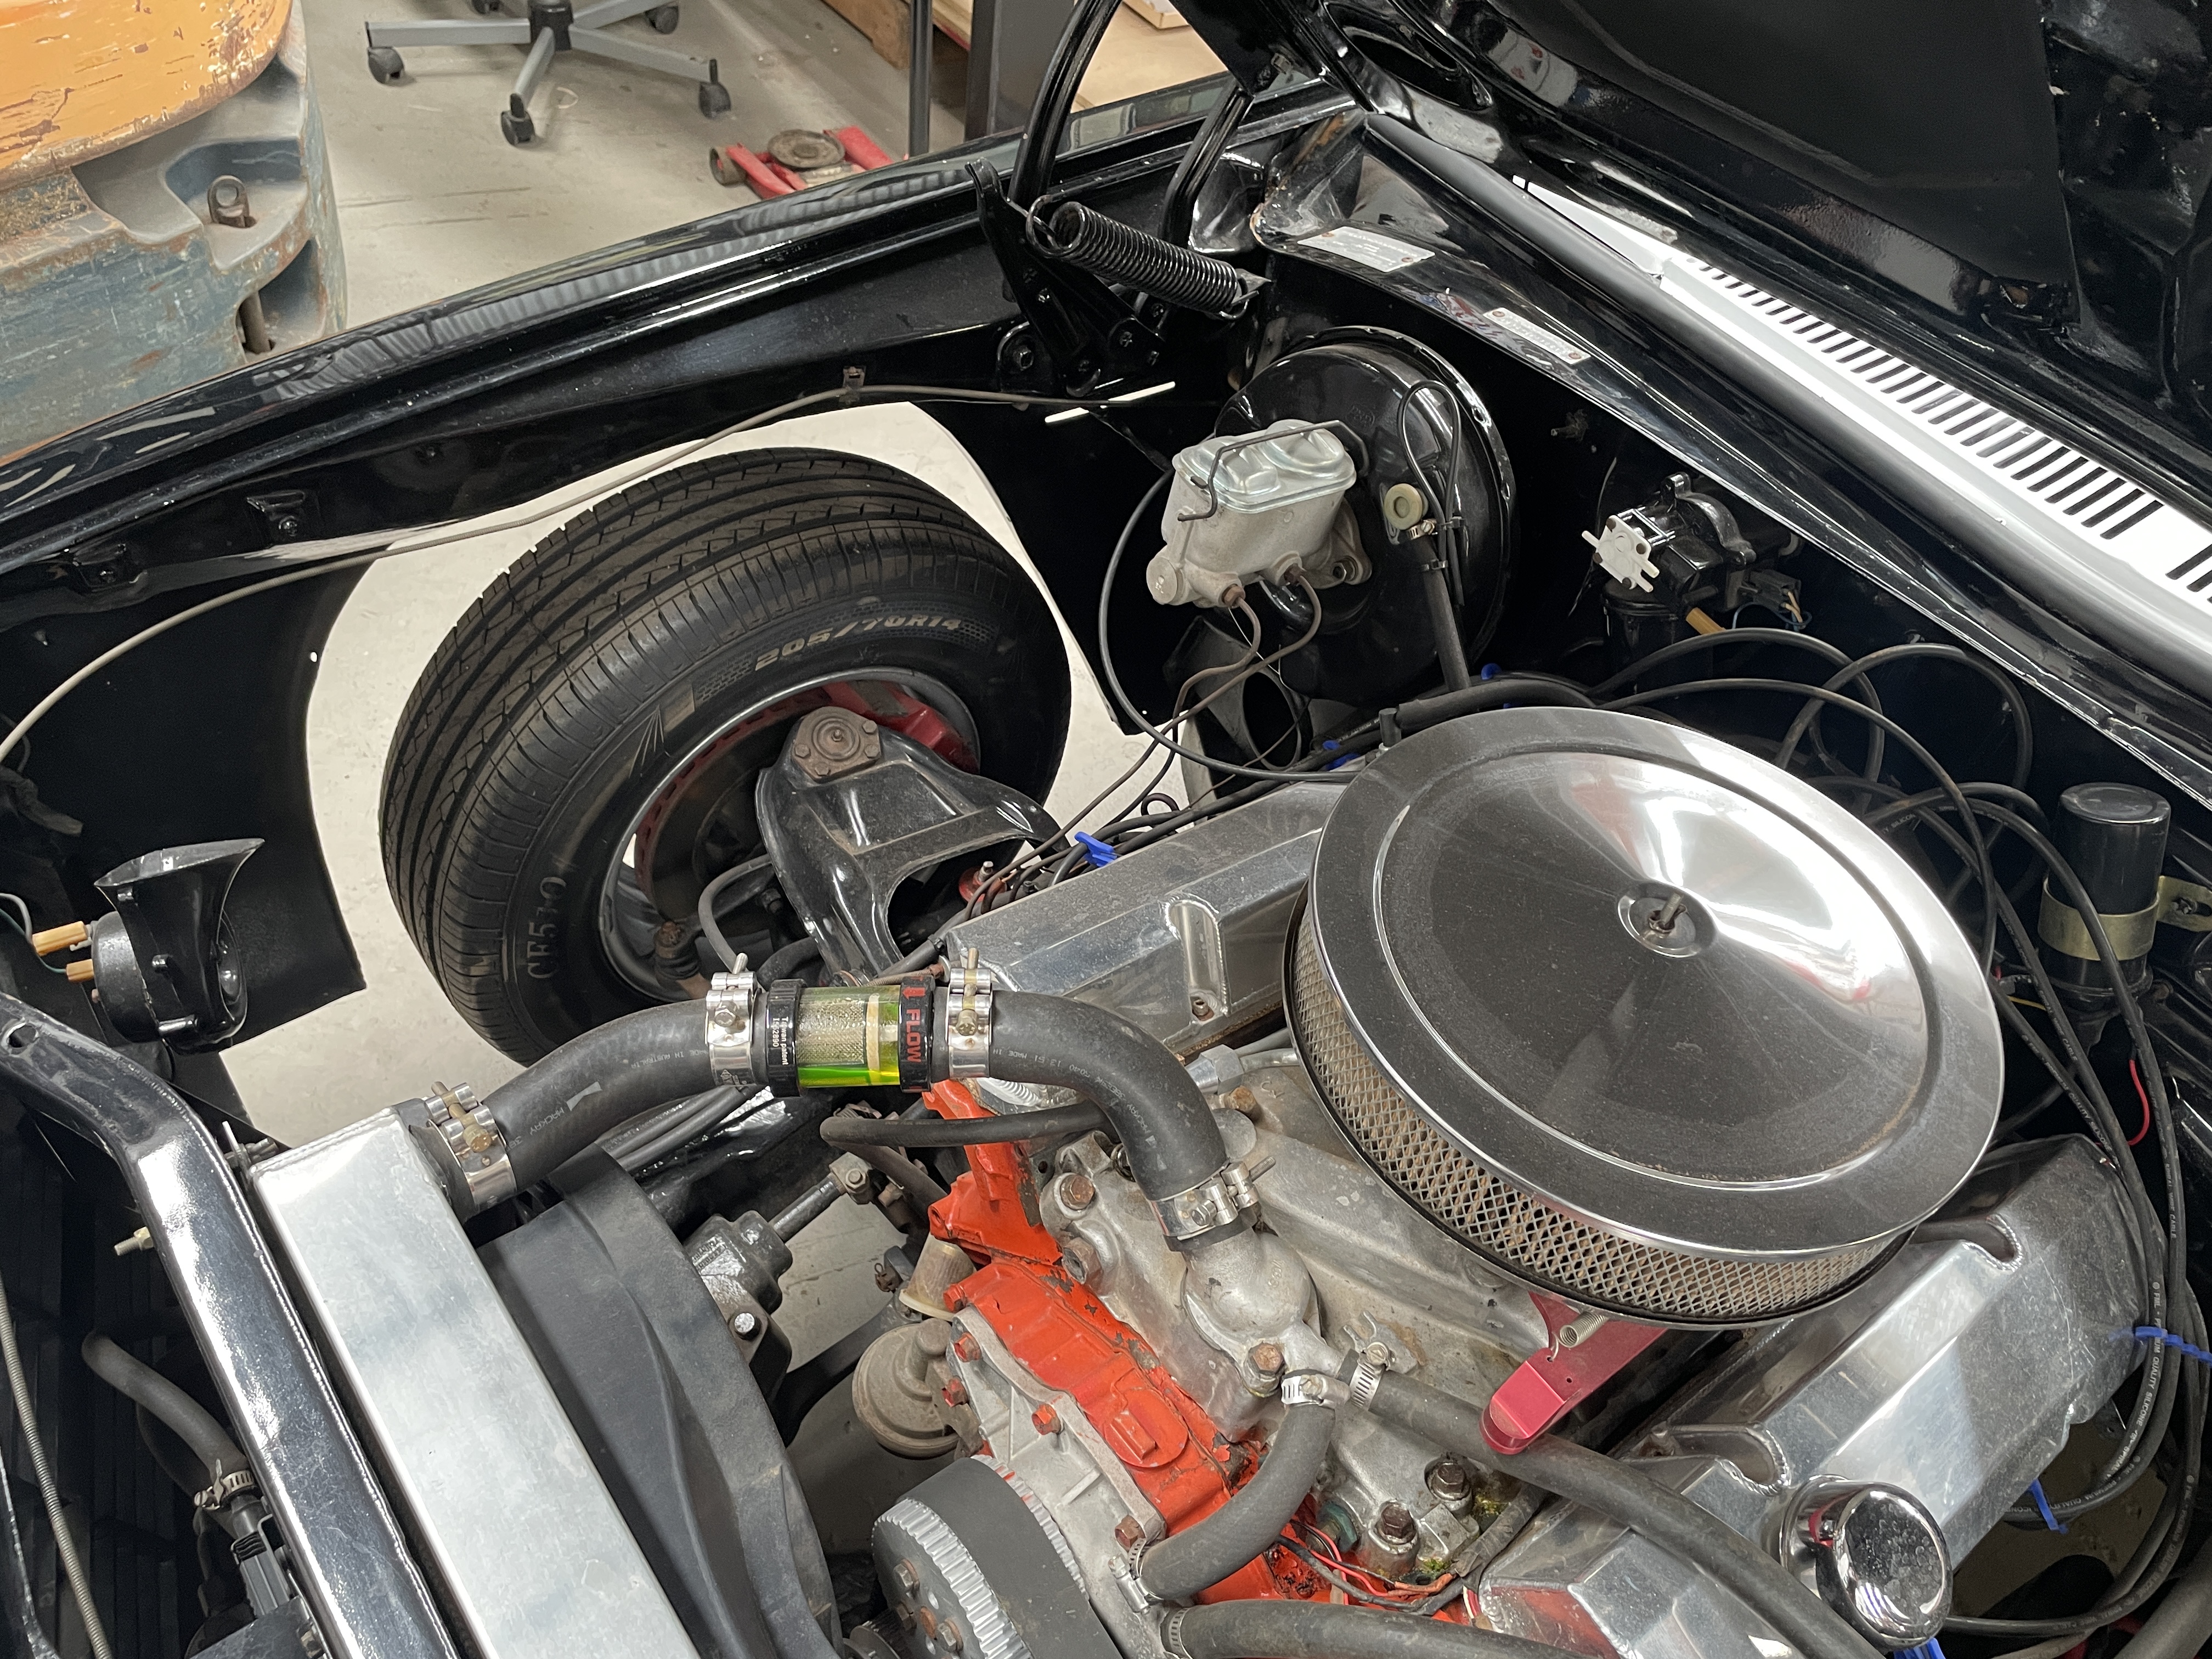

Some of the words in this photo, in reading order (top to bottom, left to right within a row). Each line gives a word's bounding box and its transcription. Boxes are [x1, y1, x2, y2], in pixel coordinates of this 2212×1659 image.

[755, 614, 962, 672] 205/70R14
[906, 1009, 922, 1063] FLOW
[630, 1053, 670, 1069] AUSTRALIA
[781, 1043, 789, 1065] patent
[1008, 1049, 1027, 1059] MADE
[527, 1105, 565, 1136] MACKAY
[2148, 1356, 2160, 1389] QUALITY
[2136, 1391, 2153, 1426] SILICONE
